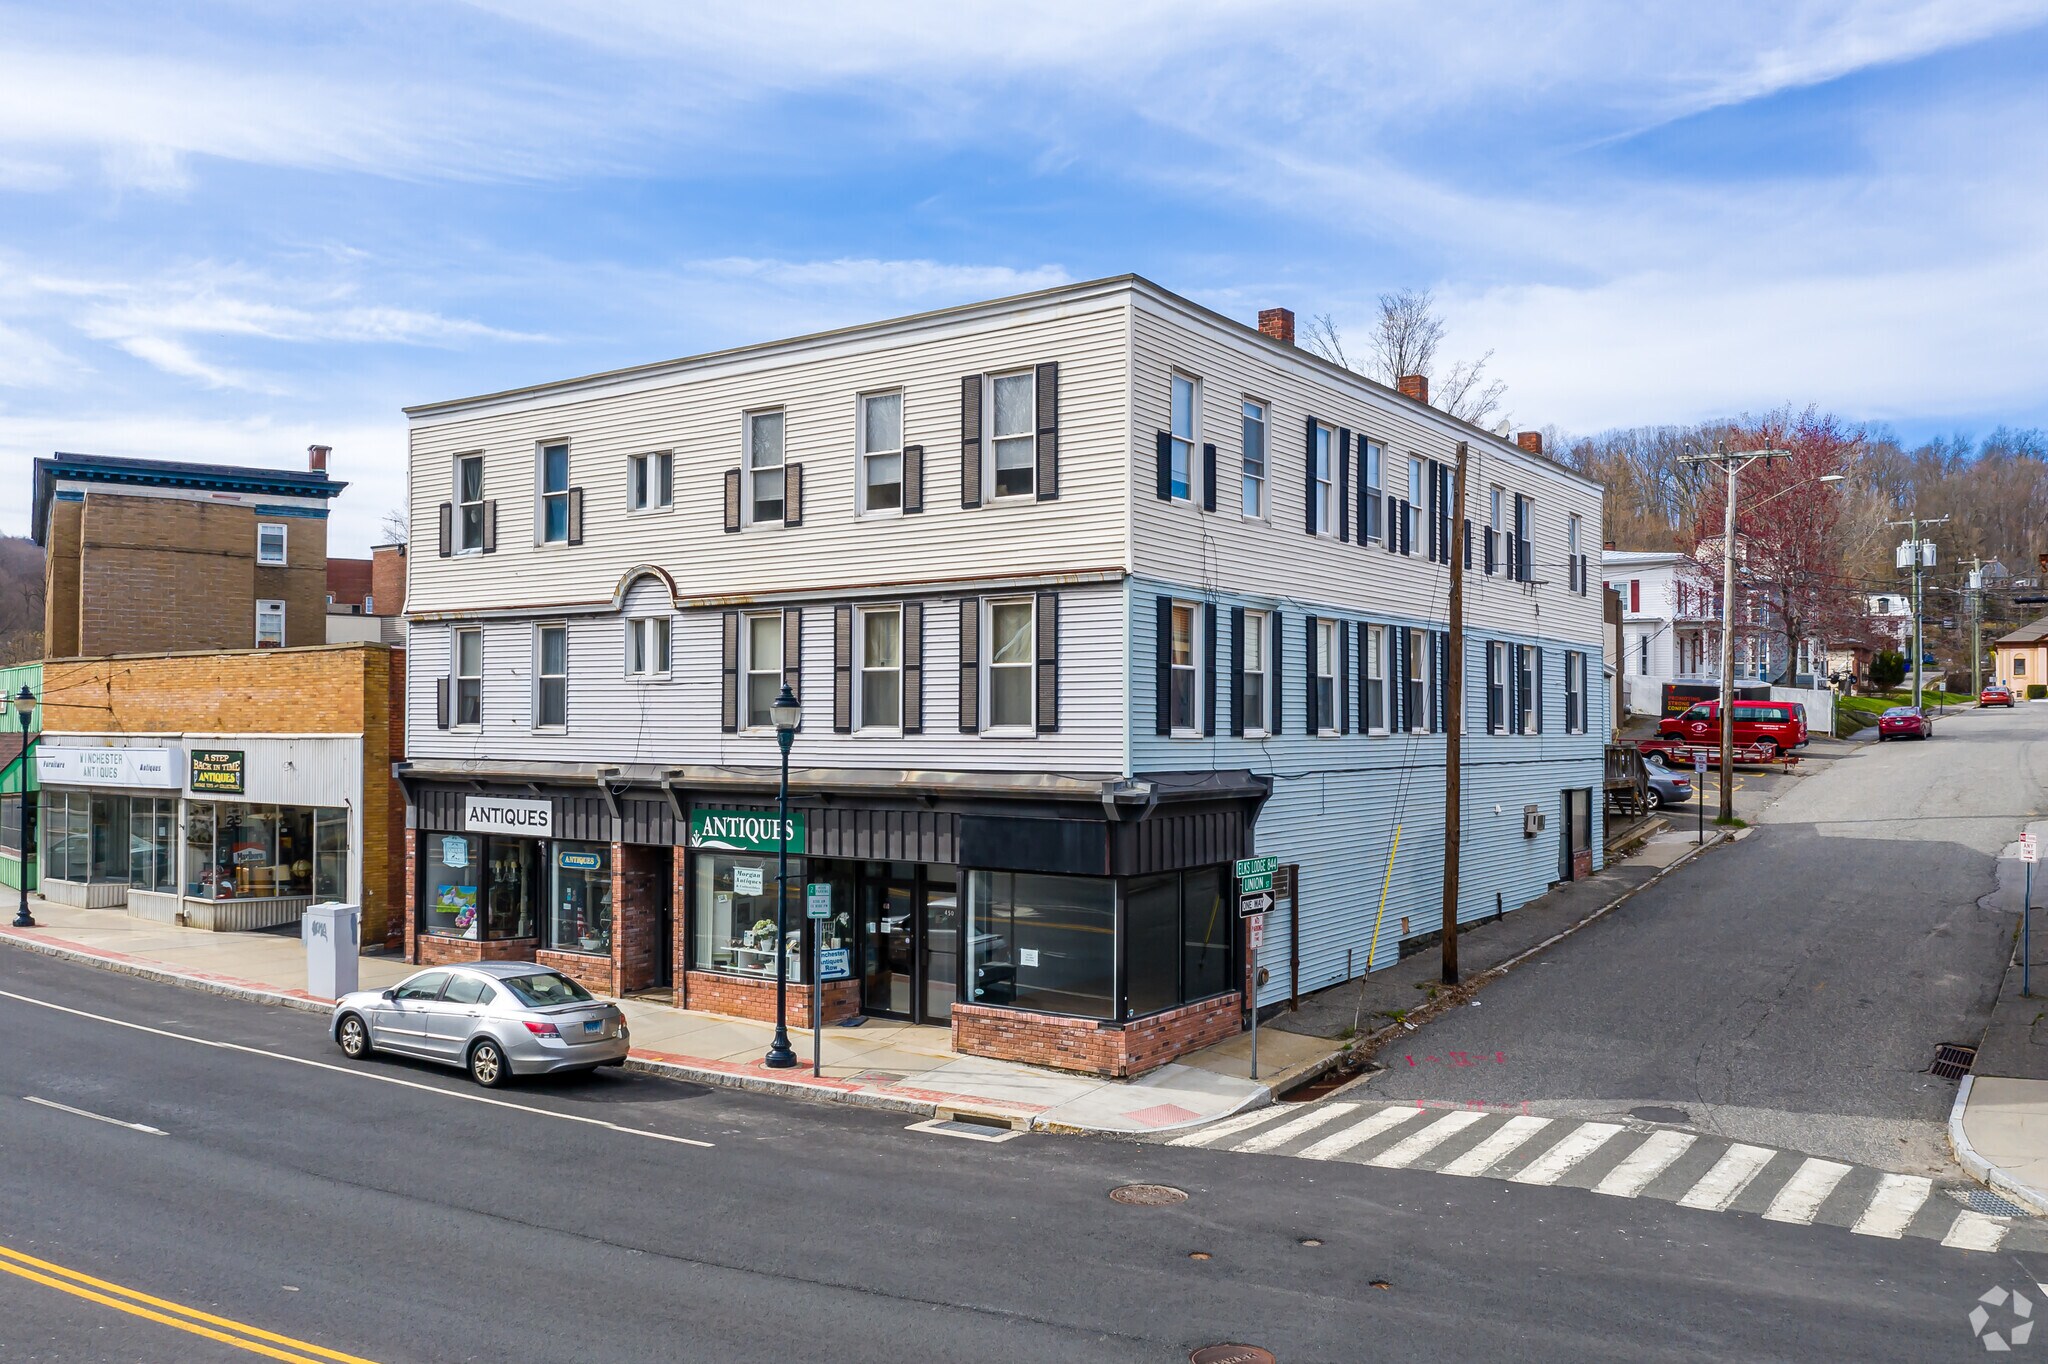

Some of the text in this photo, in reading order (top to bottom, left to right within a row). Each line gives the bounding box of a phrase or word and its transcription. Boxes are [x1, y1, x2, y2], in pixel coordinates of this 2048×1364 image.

[80, 753, 122, 764] WINCHESTER
[140, 764, 161, 772] Antiques
[194, 759, 212, 770] BACK
[222, 760, 240, 772] TIME
[83, 767, 118, 778] ANTIQUES
[198, 772, 236, 783] ANTIQUES
[226, 815, 242, 827] 25
[469, 806, 548, 827] ANTIQUES
[702, 816, 794, 844] ANTIQUES
[565, 856, 594, 865] ANTIQUES
[1238, 858, 1277, 875] ELKS LODGE 844
[737, 870, 760, 878] Morgan
[736, 878, 762, 886] Antiques
[1244, 876, 1264, 891] UNION
[1242, 898, 1264, 910] ONE WAY
